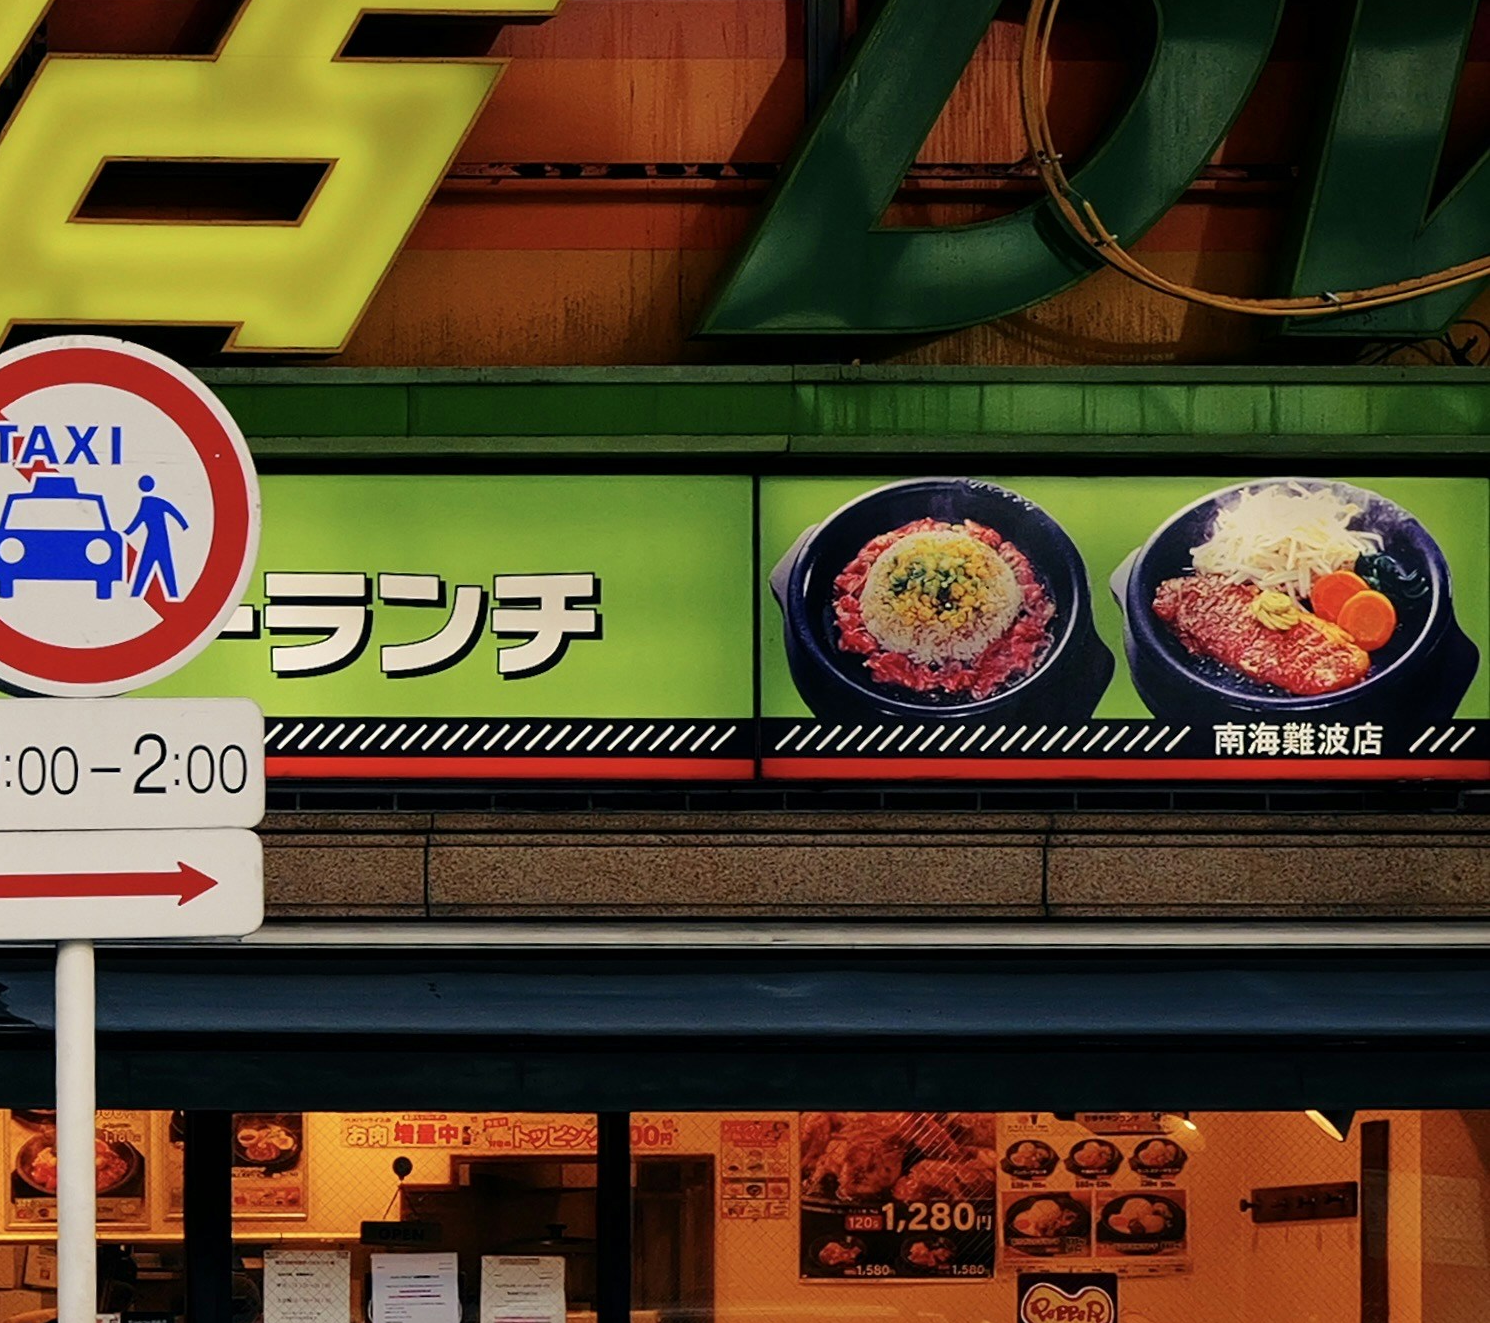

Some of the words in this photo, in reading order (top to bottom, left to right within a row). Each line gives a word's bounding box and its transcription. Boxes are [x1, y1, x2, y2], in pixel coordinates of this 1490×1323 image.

[1214, 723, 1384, 757] 南海難波店
[346, 1127, 389, 1147] お肉
[394, 1122, 459, 1146] 増量中
[379, 1227, 425, 1241] OPEN
